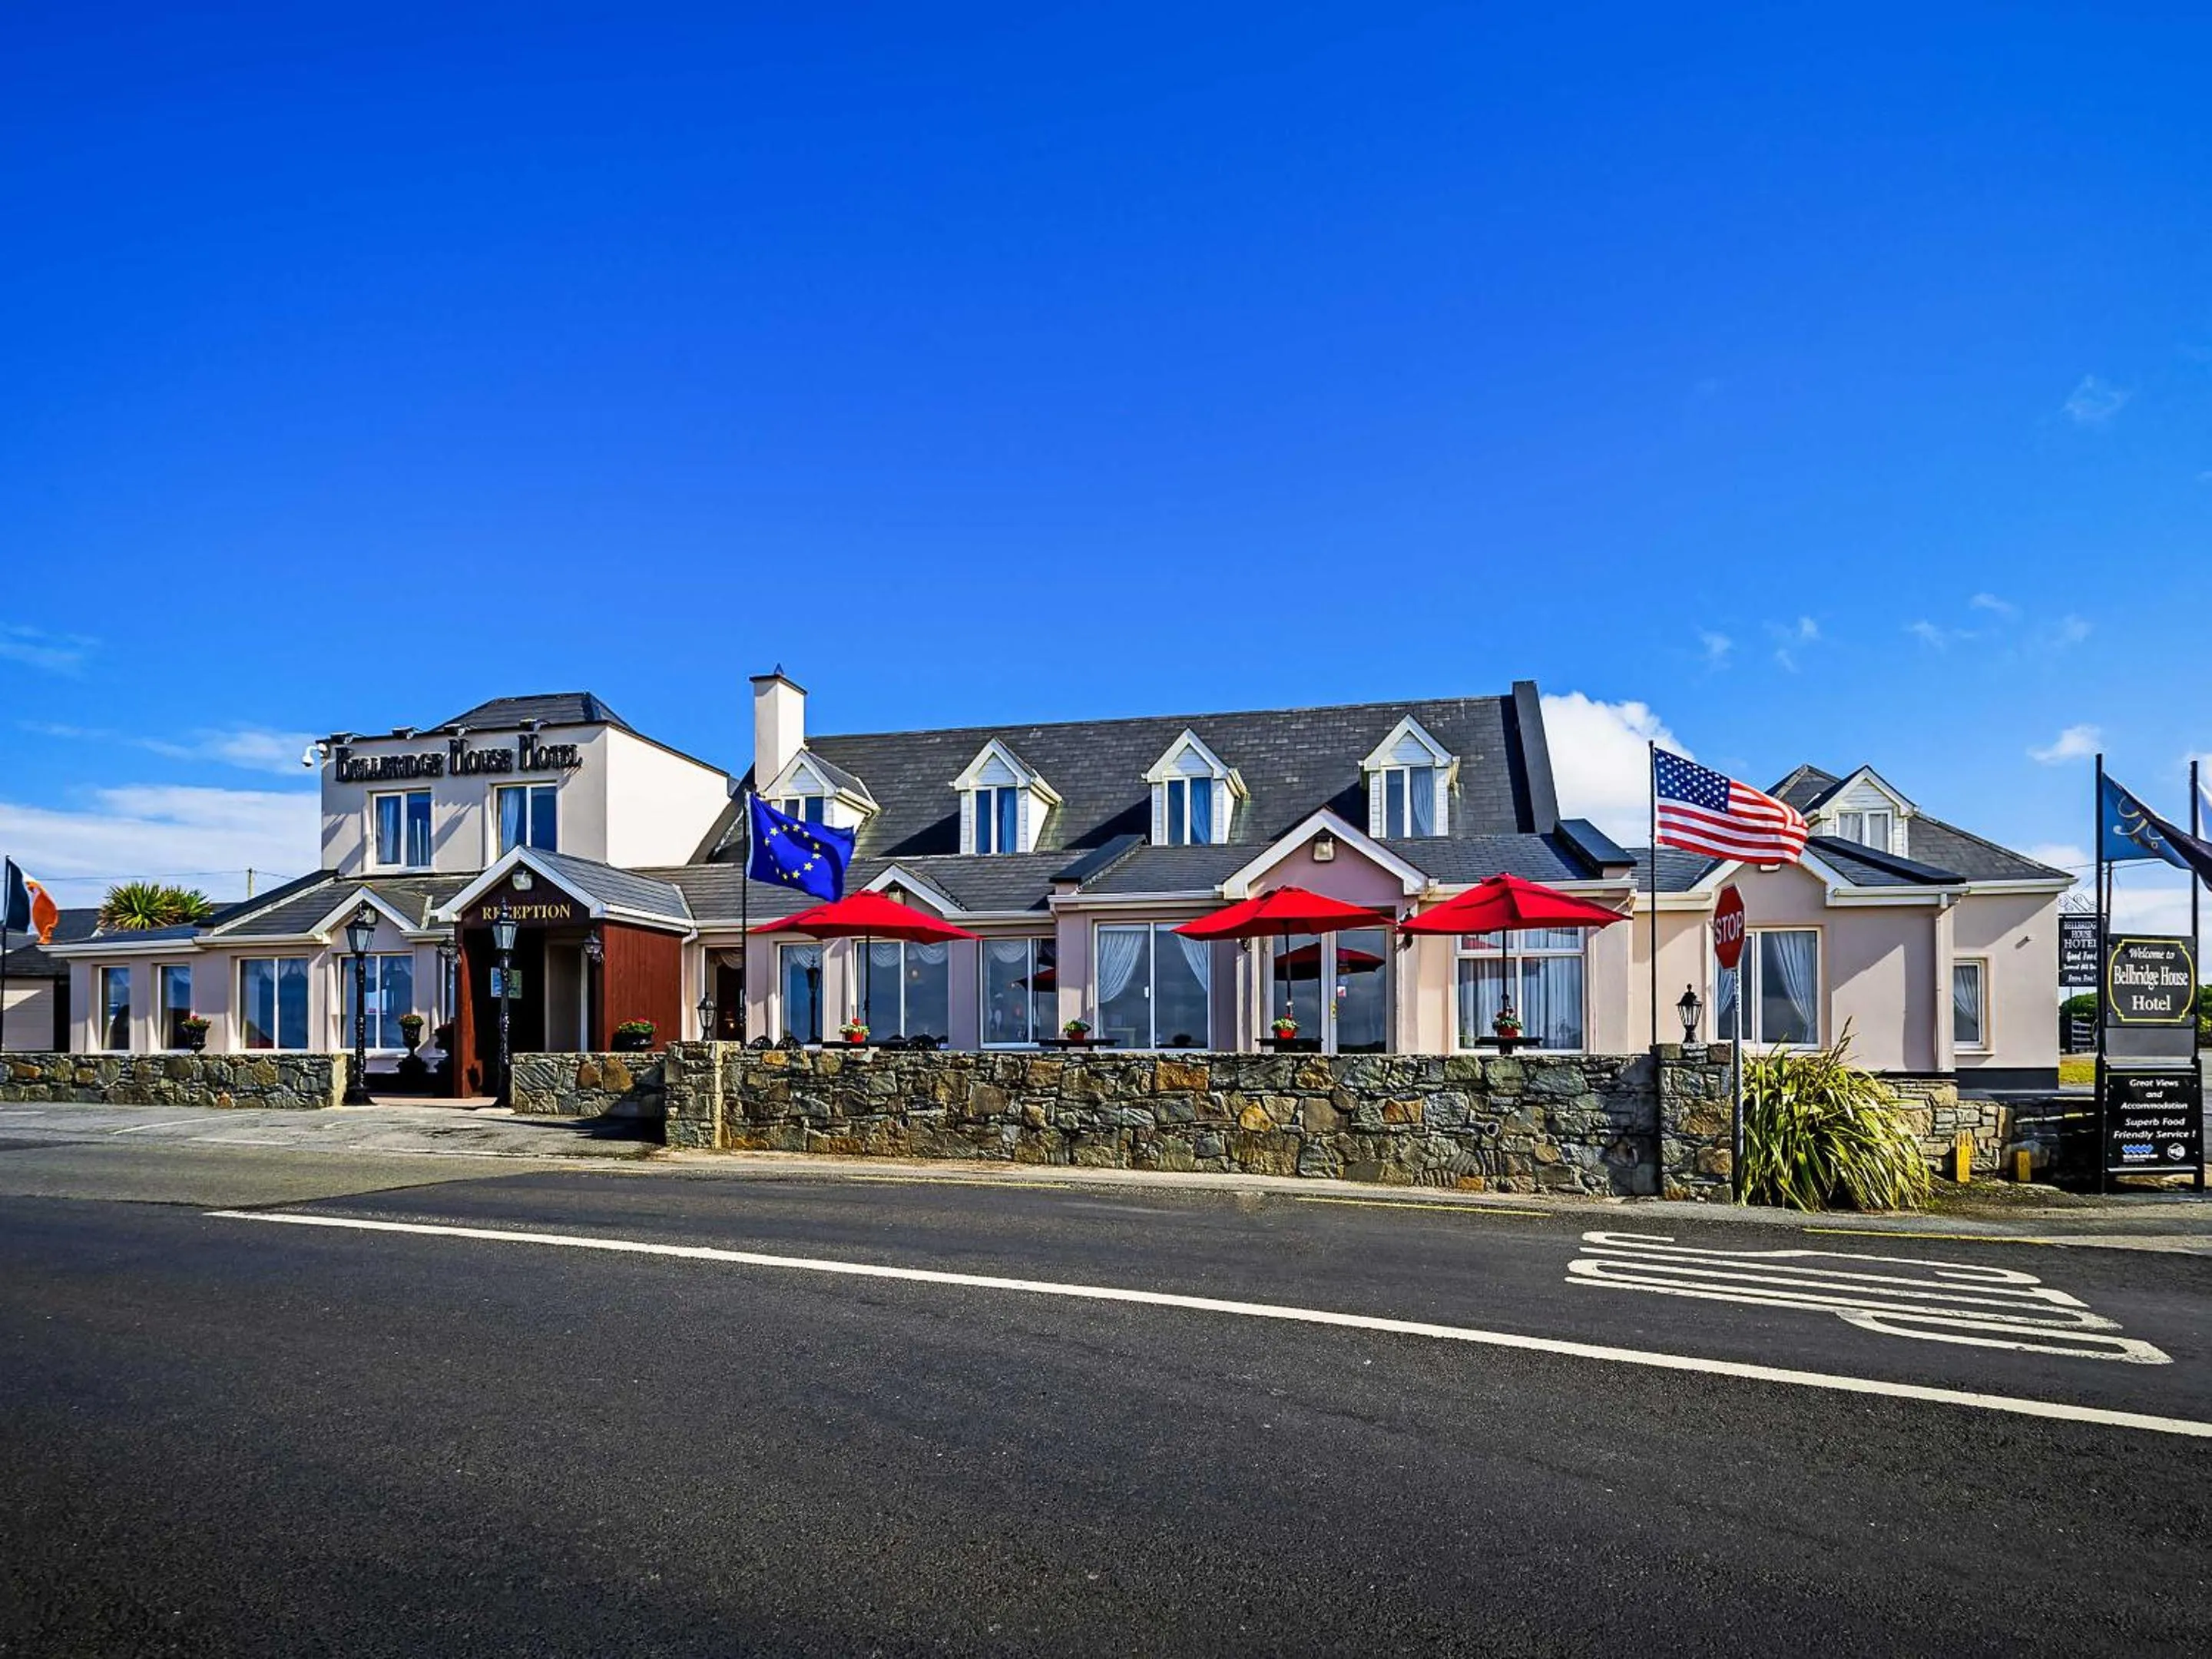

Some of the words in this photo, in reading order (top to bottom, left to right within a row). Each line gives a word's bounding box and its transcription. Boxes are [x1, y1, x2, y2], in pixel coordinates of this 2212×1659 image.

[448, 738, 512, 775] HOUSE
[518, 733, 583, 770] HOTEL
[482, 904, 571, 920] REEPTION
[1715, 911, 1743, 945] STOP
[2128, 946, 2164, 959] Welcome
[2166, 949, 2175, 959] to
[2114, 963, 2159, 990] Bellbridge
[2161, 966, 2188, 986] House
[2131, 995, 2172, 1011] Hotel
[2129, 1078, 2153, 1088] Great
[2156, 1078, 2179, 1088] Views
[2124, 1118, 2160, 1128] Superb
[2162, 1118, 2186, 1126] Food
[2113, 1130, 2153, 1141] Friendly
[2155, 1130, 2189, 1138] Service
